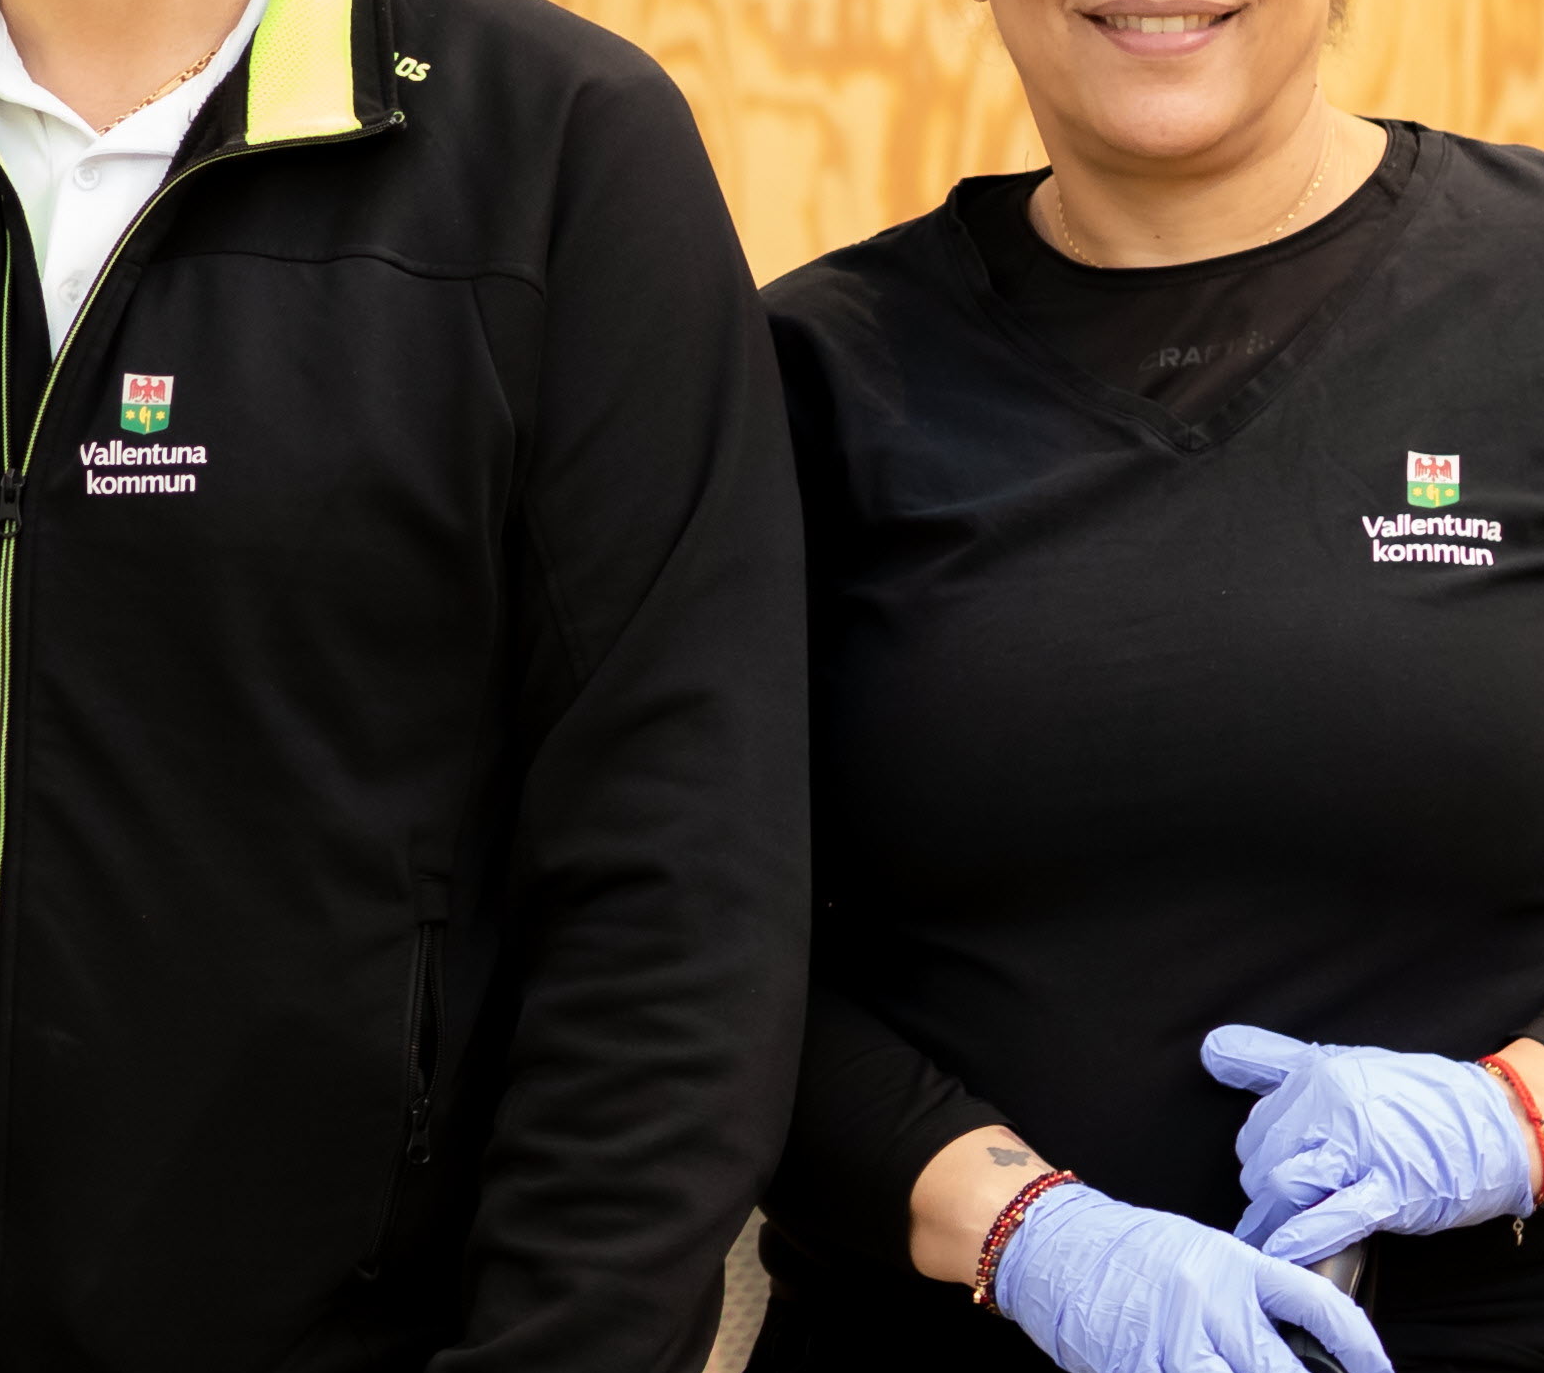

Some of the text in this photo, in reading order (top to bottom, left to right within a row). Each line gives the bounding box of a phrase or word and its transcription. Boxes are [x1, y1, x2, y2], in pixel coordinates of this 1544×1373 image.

[80, 440, 208, 466] Vallentuna
[86, 470, 196, 495] kommun
[1362, 514, 1502, 542] Vallentuna
[1372, 539, 1494, 566] kommun
